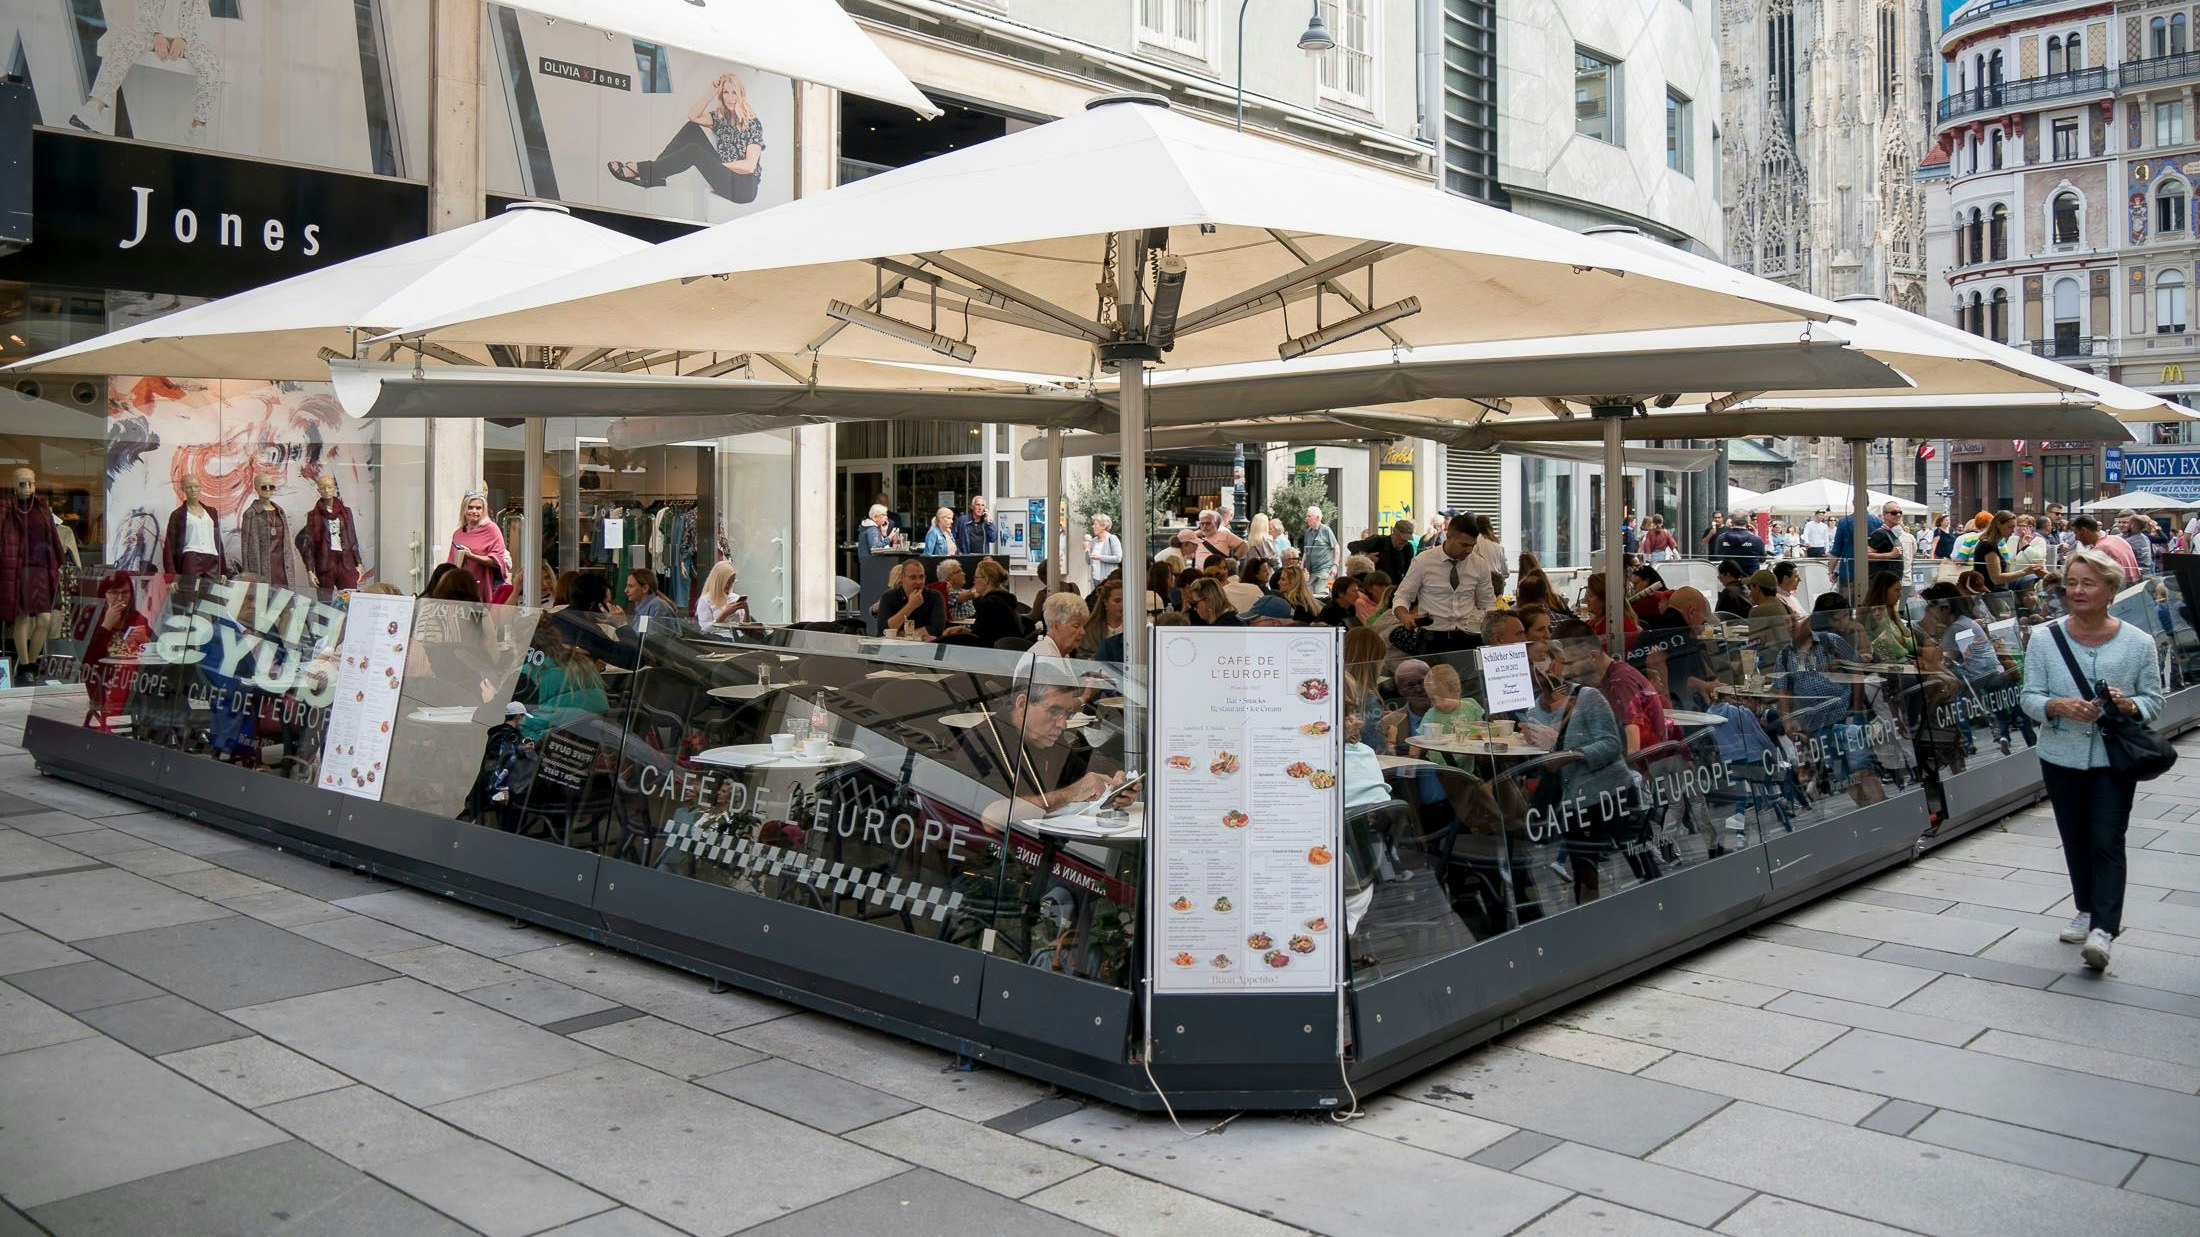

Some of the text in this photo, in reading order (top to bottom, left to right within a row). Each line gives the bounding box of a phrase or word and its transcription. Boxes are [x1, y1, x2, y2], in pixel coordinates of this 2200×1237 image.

[544, 61, 581, 78] OLIVIA
[590, 69, 627, 87] Jones
[119, 186, 320, 256] Jones
[2124, 457, 2177, 475] MONEY
[2136, 484, 2155, 493] THE
[1211, 668, 1280, 679] L'EUROPE
[1217, 655, 1275, 666] CAFE DE
[81, 663, 99, 684] DE
[102, 664, 169, 697] L'EUROPE
[188, 682, 332, 731] CAFÉ DE L'EUROP
[1966, 697, 1982, 719] DE
[1982, 686, 2022, 714] L'EUROP
[1809, 735, 1832, 763] DE
[1834, 717, 1902, 756] L'EUROPE
[640, 764, 716, 808] CAFÉ
[727, 782, 771, 820] DE
[785, 790, 970, 862] L'EUROPE
[1526, 759, 1737, 842] CAFÉ DE L'EUROPE
[1211, 975, 1234, 985] Buon
